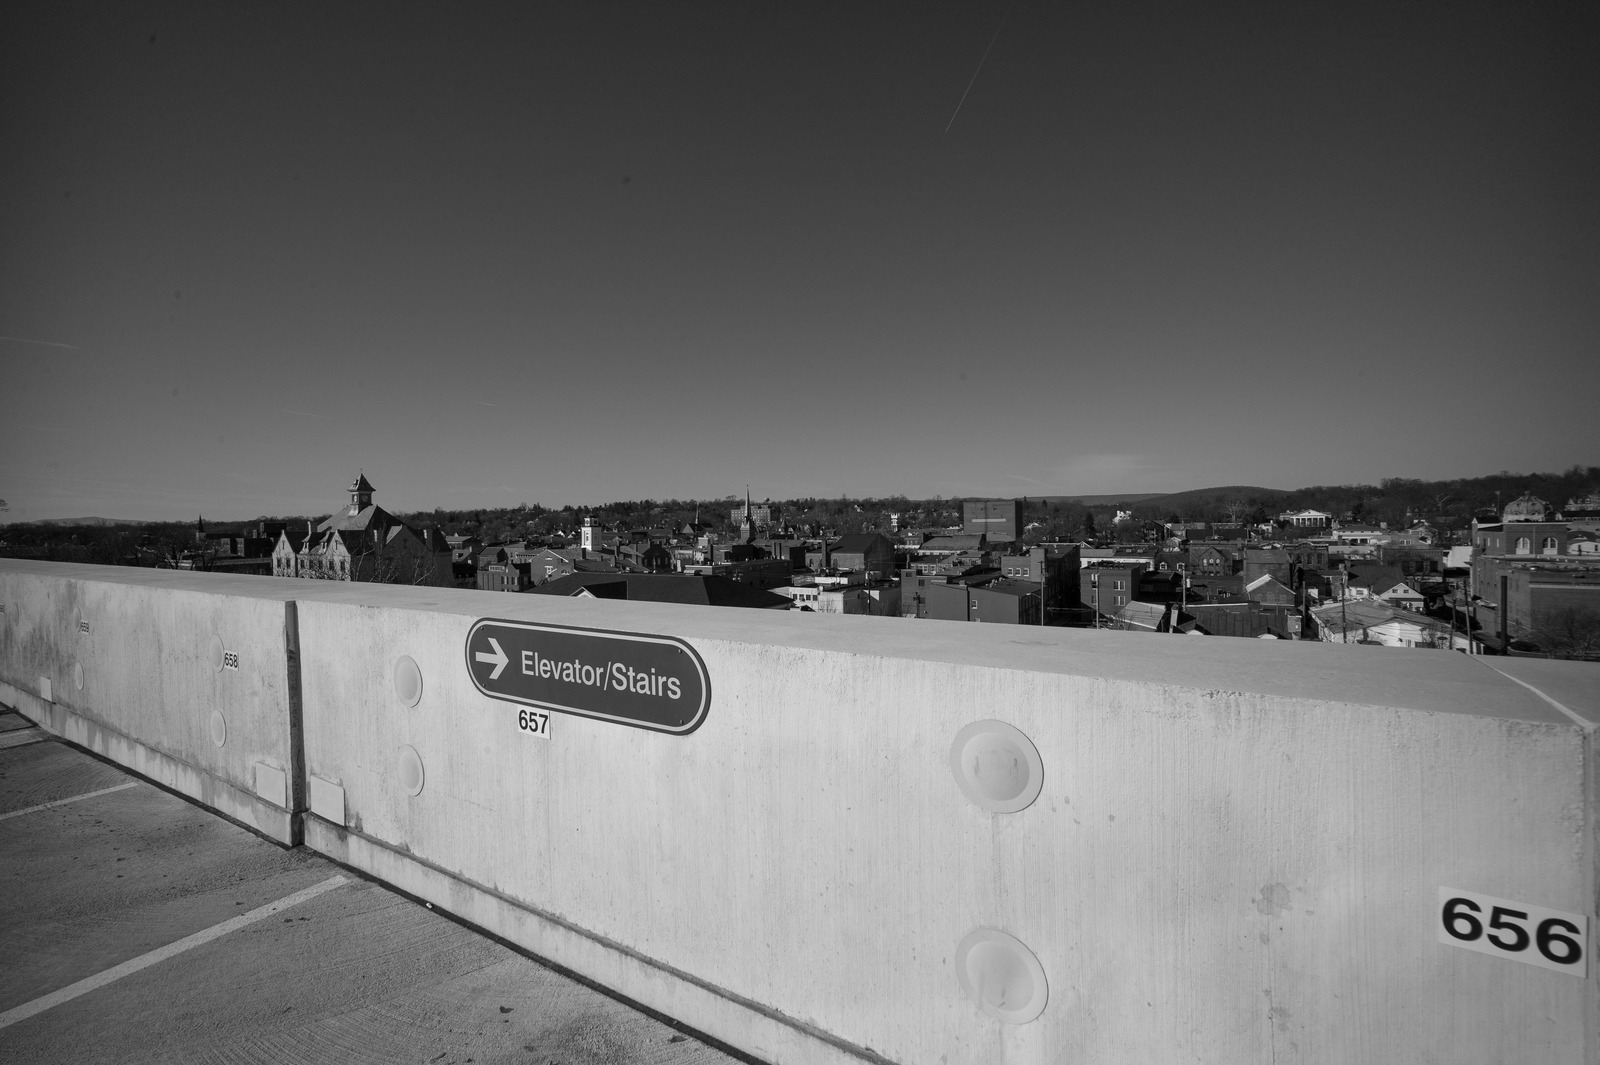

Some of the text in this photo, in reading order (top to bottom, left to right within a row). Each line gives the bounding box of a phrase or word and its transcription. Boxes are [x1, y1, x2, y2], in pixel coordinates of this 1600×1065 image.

[225, 652, 238, 668] 658
[521, 650, 681, 699] Elevator/Stairs
[519, 709, 548, 734] 657
[1442, 897, 1583, 965] 656
